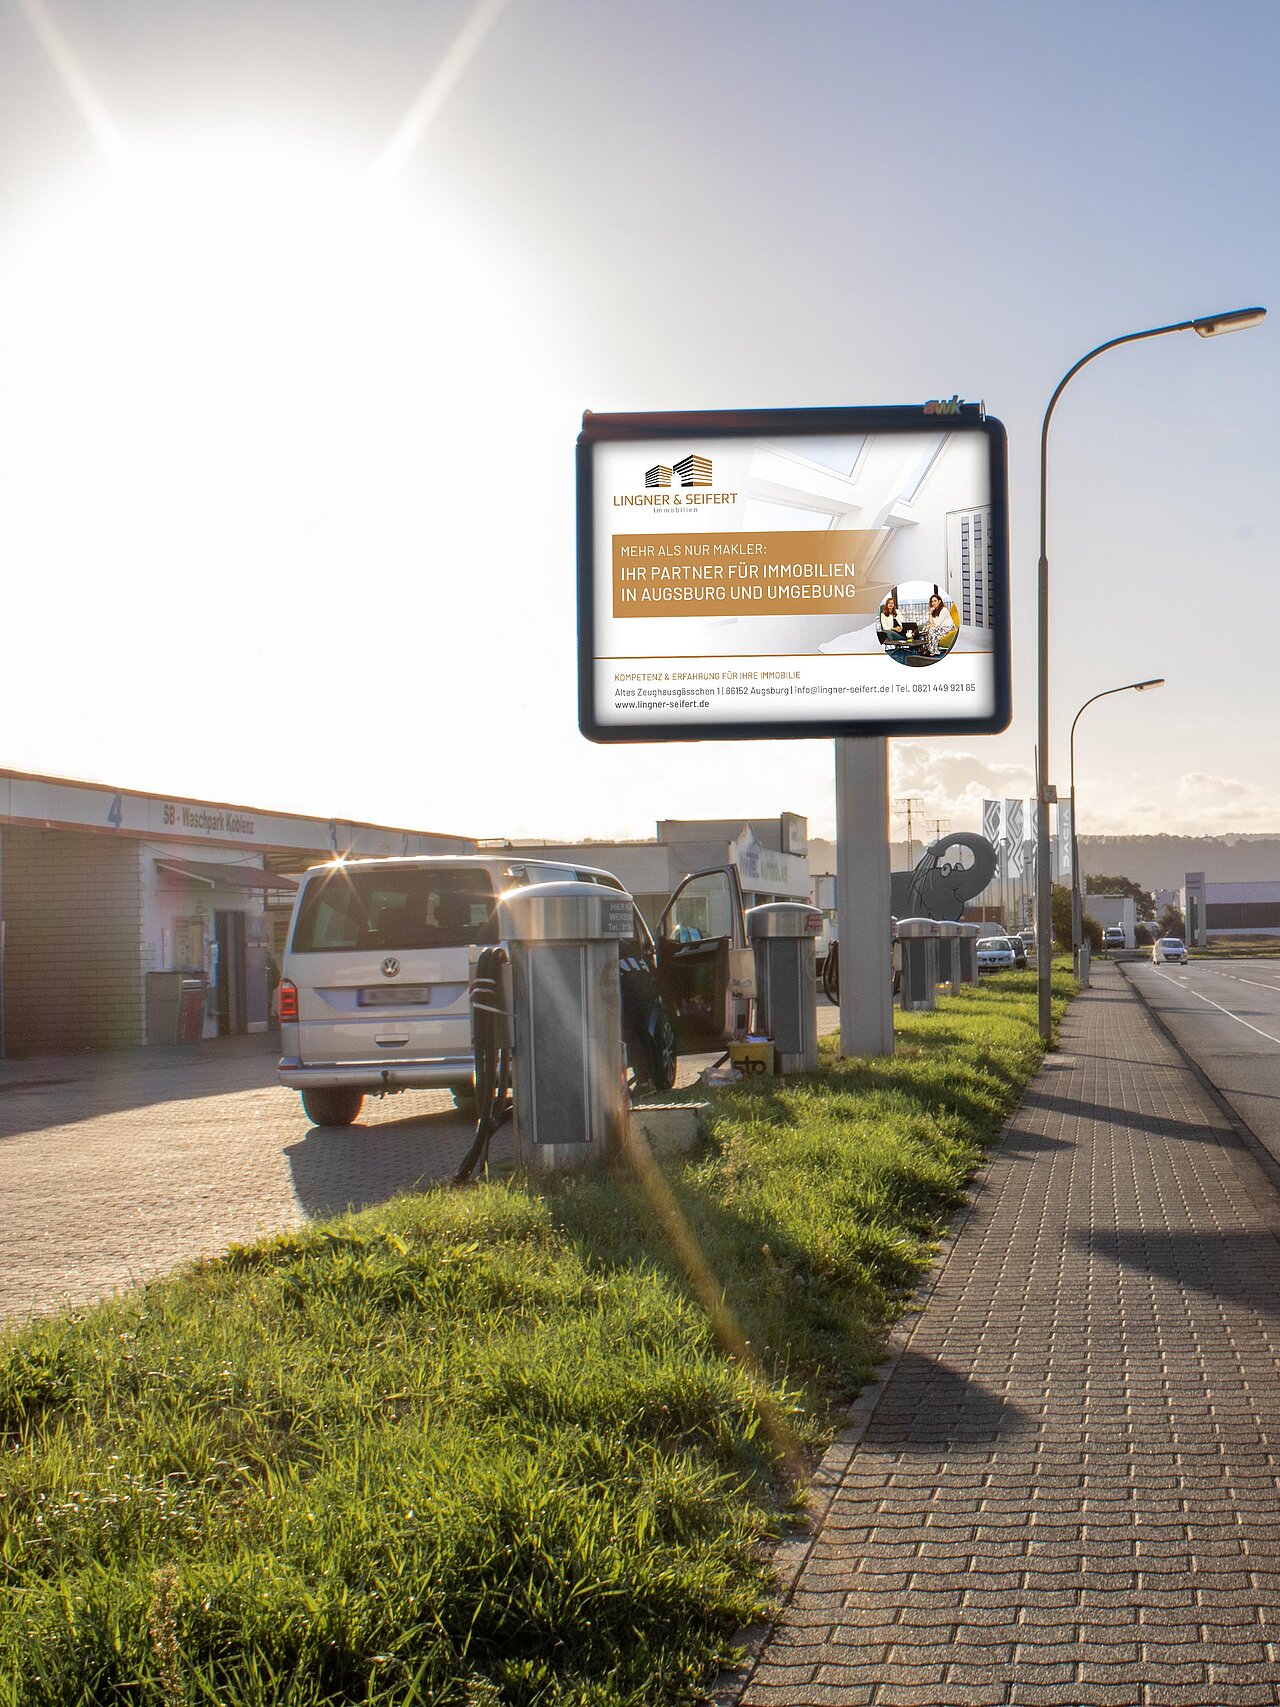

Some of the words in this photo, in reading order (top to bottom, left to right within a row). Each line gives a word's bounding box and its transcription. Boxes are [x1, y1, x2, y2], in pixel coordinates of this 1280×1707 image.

[923, 394, 965, 415] awk
[613, 494, 670, 507] LINGNER
[673, 493, 683, 506] &
[685, 492, 738, 505] SEIFERT
[653, 506, 698, 514] Immobilien
[620, 545, 655, 557] MEHR
[658, 545, 682, 556] ALS
[684, 544, 710, 556] NUR
[713, 543, 768, 555] MAKLER:
[620, 566, 647, 581] IHR
[651, 564, 724, 580] PARTNER
[728, 561, 759, 579] FÜR
[763, 562, 856, 578] IMMOBILIEN
[620, 587, 637, 602] IN
[641, 585, 726, 602] AUGSBURG
[729, 585, 763, 600] UND
[766, 583, 856, 600] UMGEBUNG
[614, 673, 663, 682] KOMPETENZ
[664, 673, 670, 681] &
[672, 672, 720, 681] ERFAHRUNG
[721, 670, 737, 680] FÜR
[739, 671, 758, 680] IHRE
[760, 671, 800, 680] IMMOBILIE
[614, 688, 635, 697] Altes
[637, 686, 715, 698] Zeughausgässchen
[725, 686, 748, 696] 86152
[750, 686, 789, 697] Augsburg
[794, 683, 890, 696] info@lingner-seifert.de
[895, 684, 911, 693] Tel.
[912, 684, 931, 693] 0821
[932, 683, 949, 693] 449
[950, 683, 964, 692] 921
[965, 683, 976, 692] 85
[614, 700, 710, 710] www.lingner-seifert.de
[107, 791, 123, 832] 4
[163, 803, 176, 825] SB
[182, 806, 225, 835] Waschpark
[226, 809, 255, 835] Koblenz
